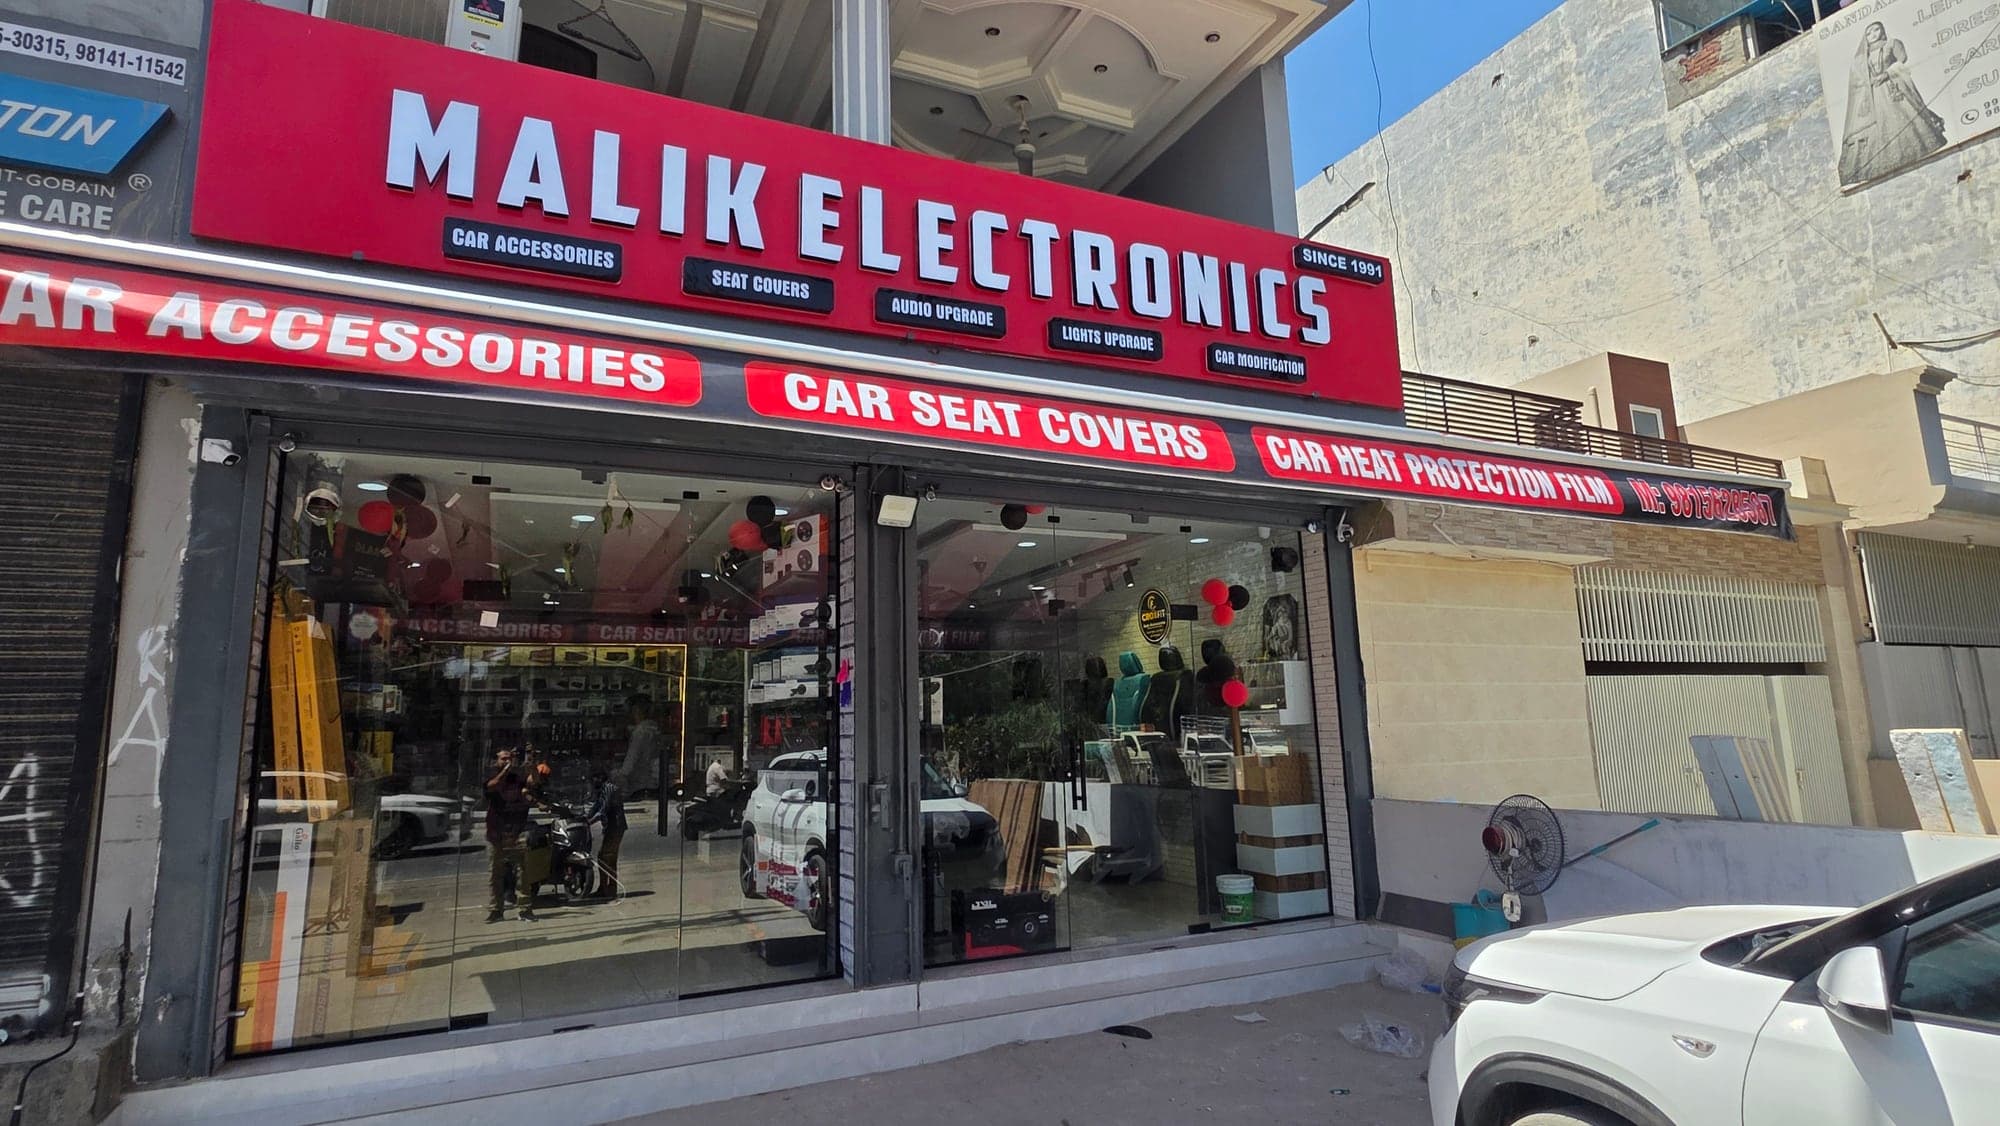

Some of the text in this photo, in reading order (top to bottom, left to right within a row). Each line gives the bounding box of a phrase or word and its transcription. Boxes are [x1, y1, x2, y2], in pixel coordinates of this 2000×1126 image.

[75, 43, 184, 80] 98141-11542
[20, 194, 113, 230] CARE
[386, 88, 1332, 346] MALIK ELECTRONICS
[452, 228, 615, 269] CAR ACCESSORIES
[1303, 248, 1382, 278] SINCE 1991
[712, 269, 809, 299] SEAT COVERS
[892, 298, 994, 327] AUDIO UPGRADE
[147, 291, 665, 392] ACCESSORIES
[1063, 325, 1154, 352] LIGHTS UPGRADE
[1215, 349, 1304, 376] CAR MODIFICATION
[784, 373, 1208, 460] CAR SEAT COVERS
[1266, 435, 1331, 475] CAR
[1331, 443, 1402, 483] HEAT
[1404, 452, 1558, 500] PROTECTION
[1553, 471, 1614, 506] FILM
